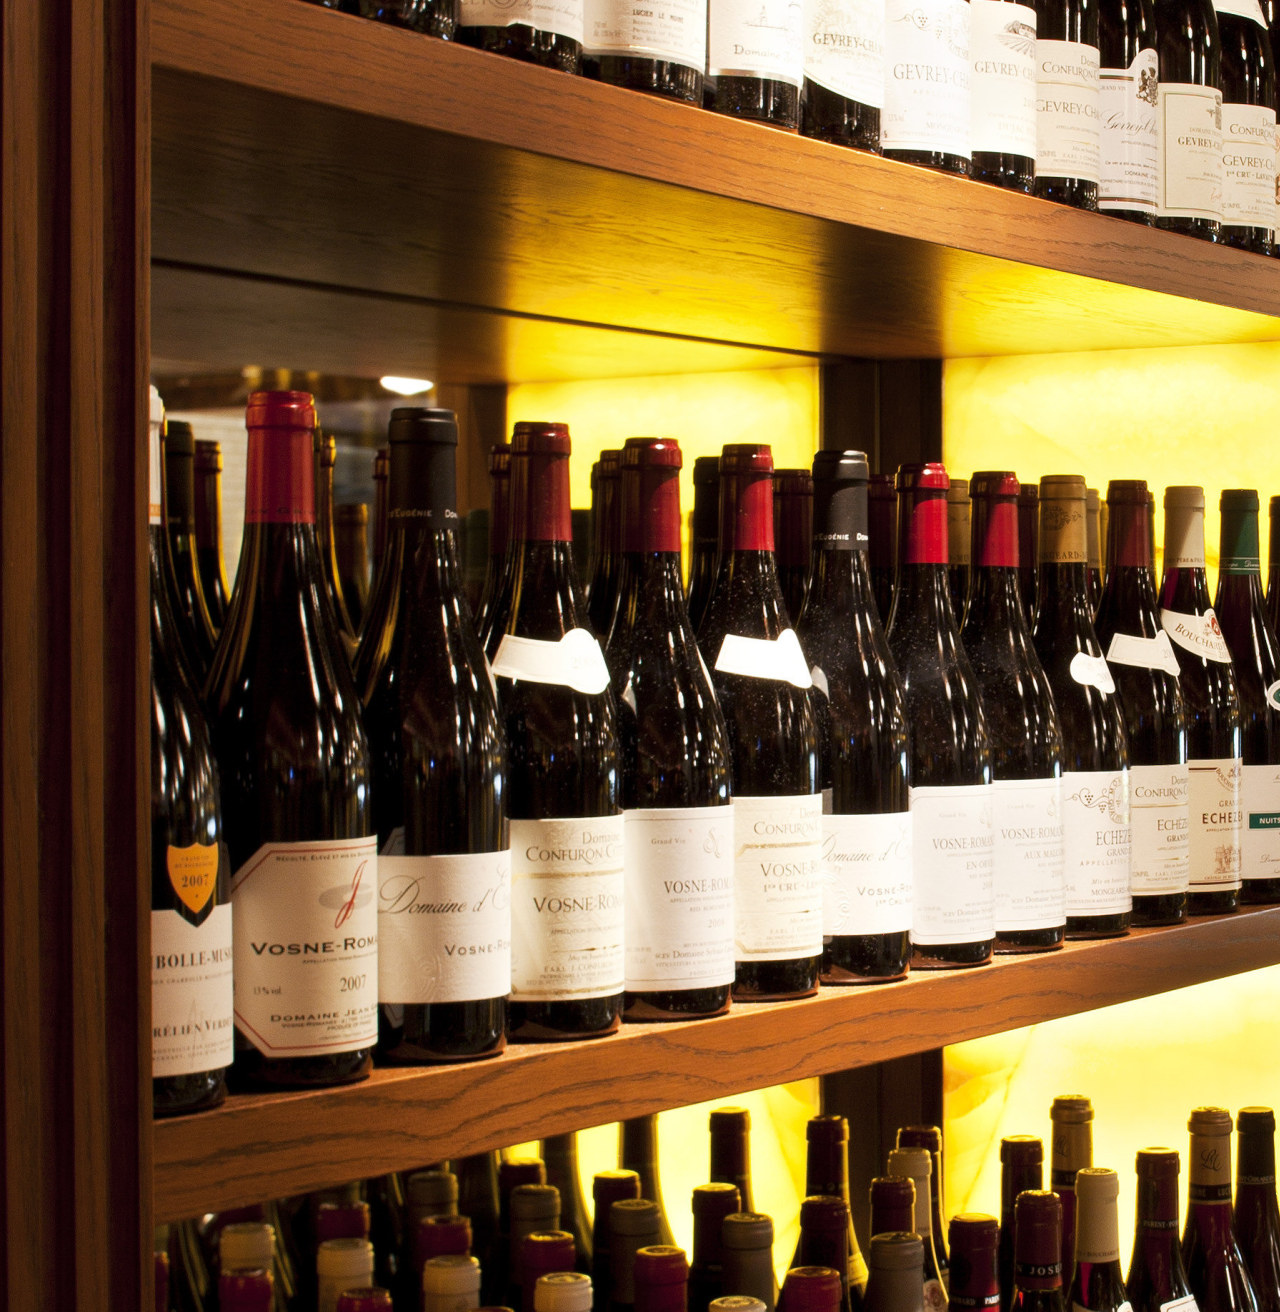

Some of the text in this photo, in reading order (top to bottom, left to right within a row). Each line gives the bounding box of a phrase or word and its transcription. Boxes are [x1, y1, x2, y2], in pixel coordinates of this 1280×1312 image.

[181, 874, 210, 889] 2007
[378, 874, 466, 915] Domaine
[340, 974, 366, 993] 2007
[270, 1012, 339, 1023] DOMAINE
[152, 1020, 200, 1038] RÉLIEN
